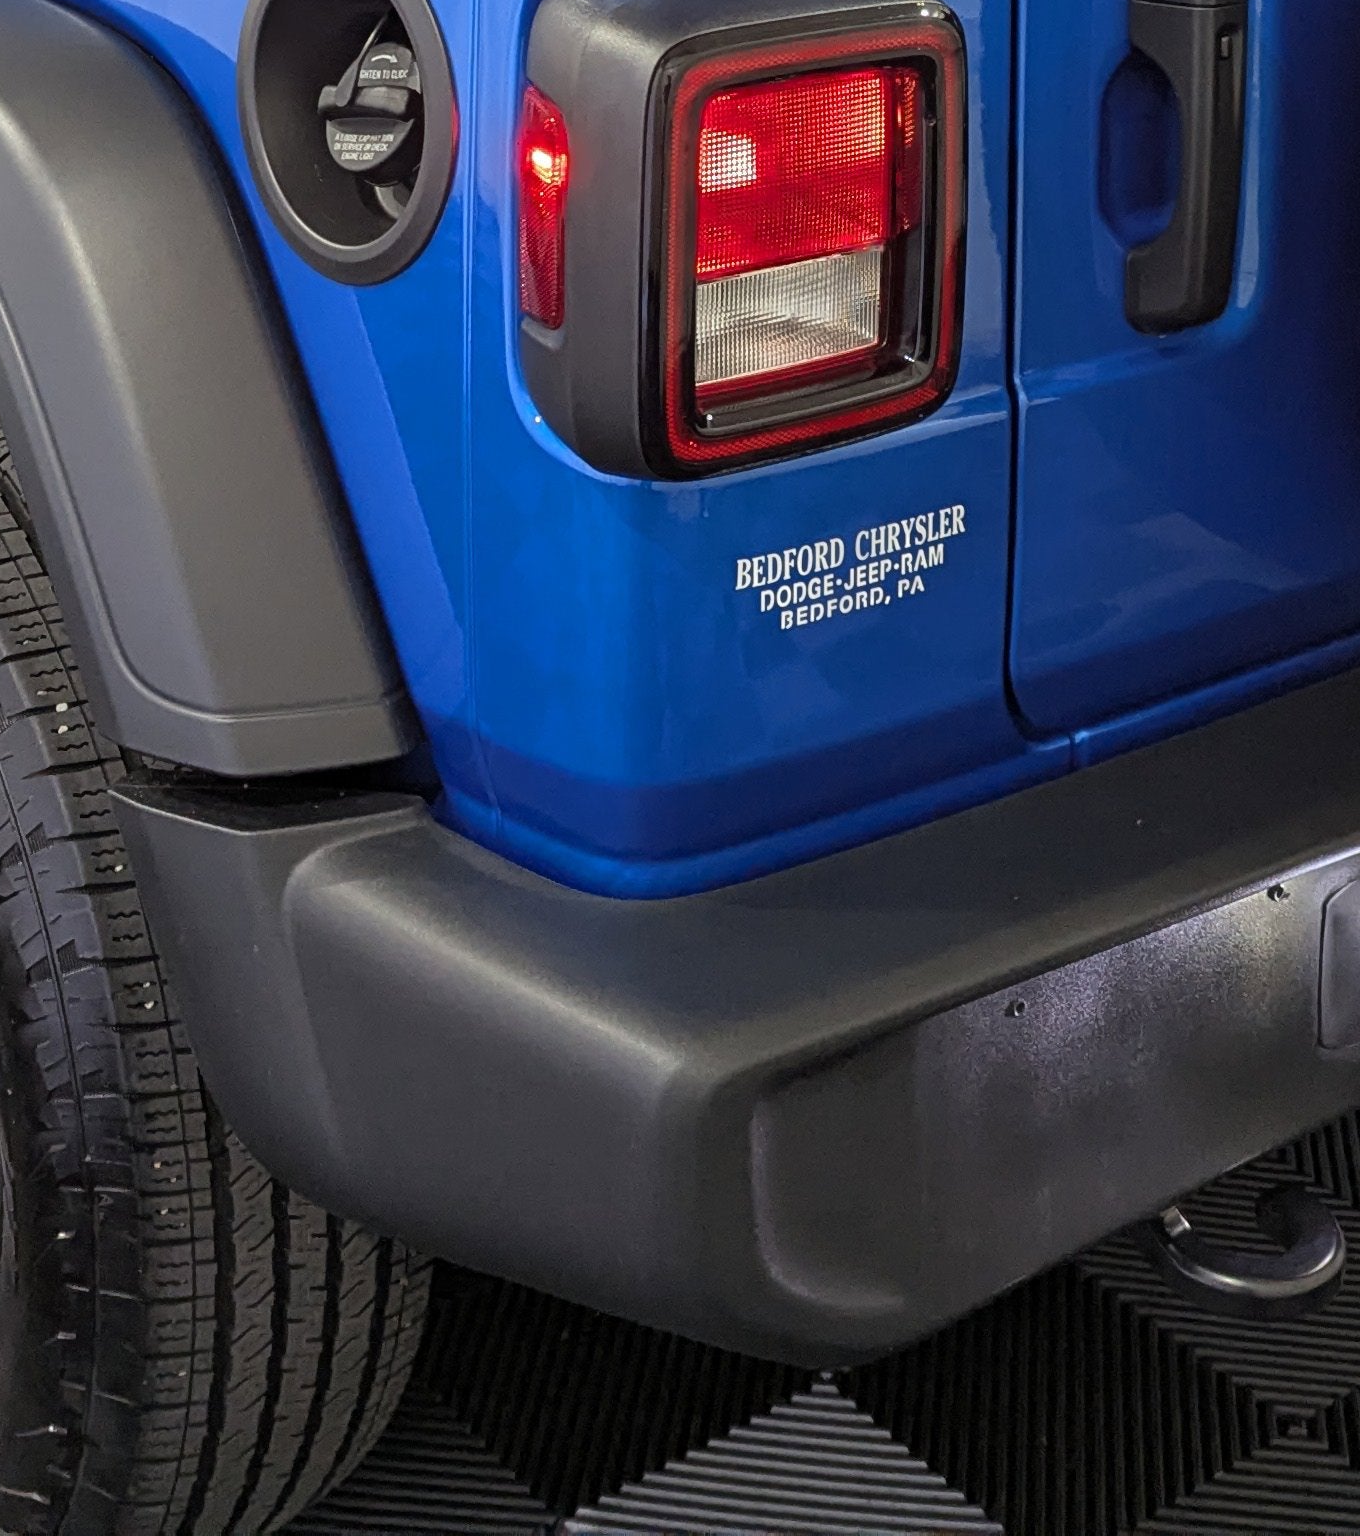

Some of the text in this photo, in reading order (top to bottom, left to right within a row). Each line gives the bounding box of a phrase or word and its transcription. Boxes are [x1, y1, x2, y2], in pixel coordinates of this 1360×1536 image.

[735, 504, 966, 590] BEDFORD CHRYSLER
[780, 575, 925, 630] BEDFORD, PA
